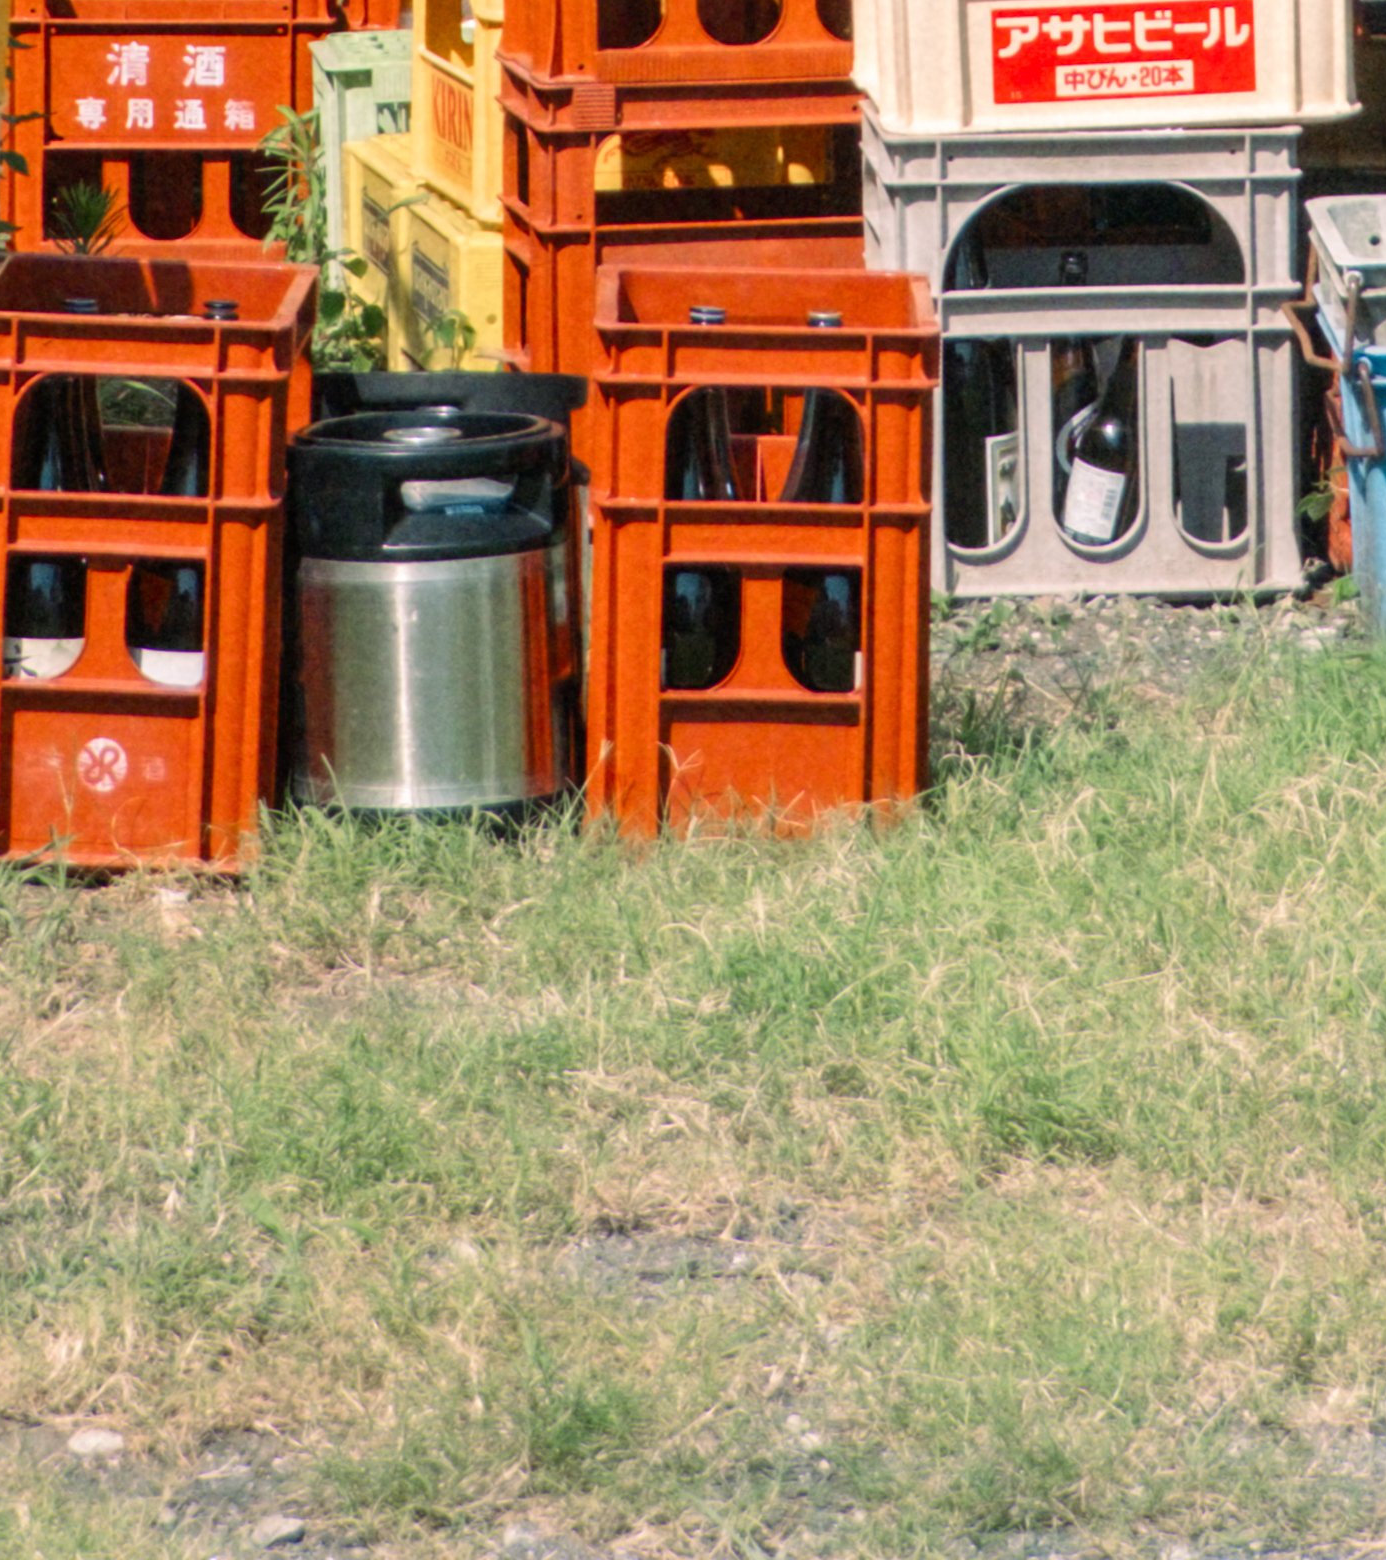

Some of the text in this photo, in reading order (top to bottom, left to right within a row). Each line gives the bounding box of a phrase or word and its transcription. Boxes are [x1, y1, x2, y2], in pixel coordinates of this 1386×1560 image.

[995, 7, 1250, 58] アサヒビール
[106, 41, 226, 87] 清酒
[1064, 65, 1185, 91] 中びん・20本
[75, 97, 255, 131] 専用通箱
